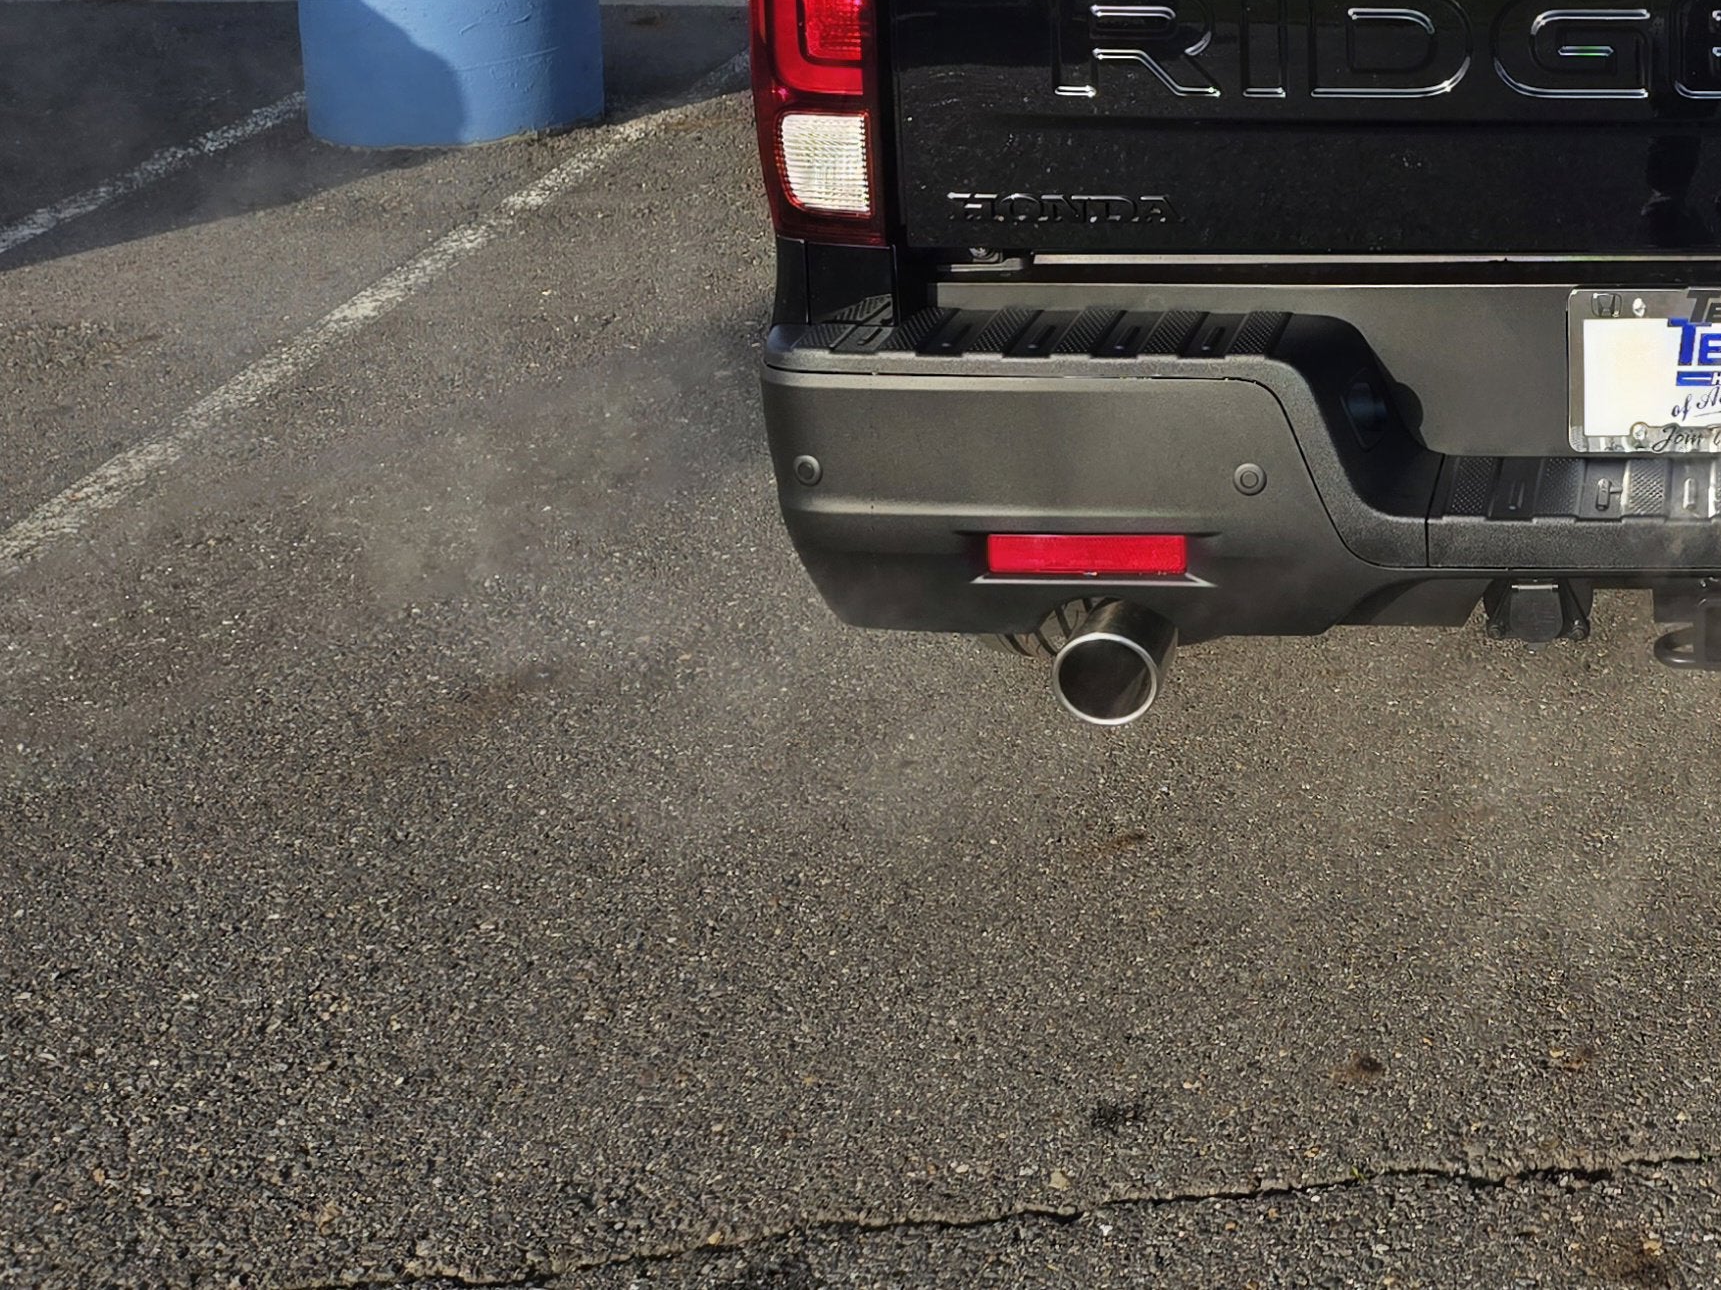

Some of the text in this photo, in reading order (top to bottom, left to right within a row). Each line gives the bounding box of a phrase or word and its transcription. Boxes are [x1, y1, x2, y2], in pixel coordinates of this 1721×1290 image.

[946, 192, 1187, 222] HONDA
[1671, 393, 1692, 421] of
[1652, 423, 1704, 452] Join
